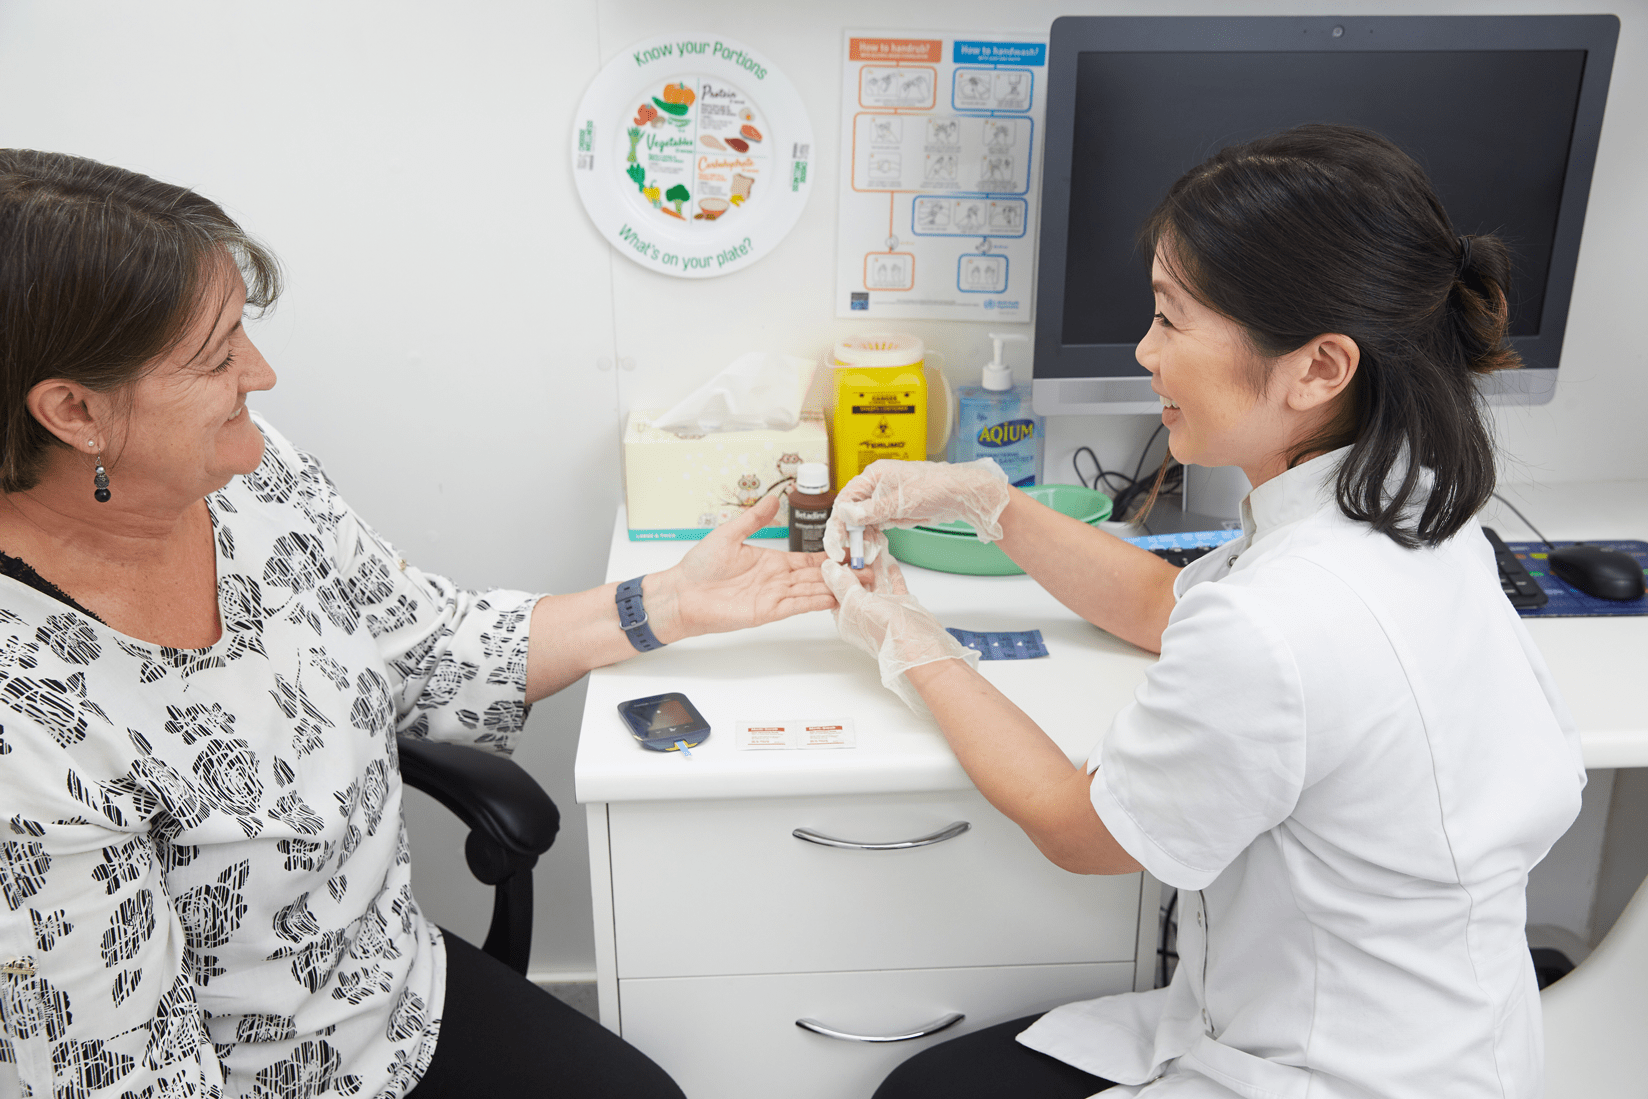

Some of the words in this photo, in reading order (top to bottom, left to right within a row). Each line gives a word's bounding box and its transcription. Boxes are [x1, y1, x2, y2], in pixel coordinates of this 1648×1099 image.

[633, 43, 673, 67] Know
[676, 41, 710, 58] your
[712, 40, 768, 80] Portions
[701, 84, 736, 101] Protein
[646, 133, 694, 153] Vegetables
[619, 224, 660, 260] What's
[662, 253, 679, 266] on
[682, 256, 714, 272] your
[716, 237, 754, 268] plate?
